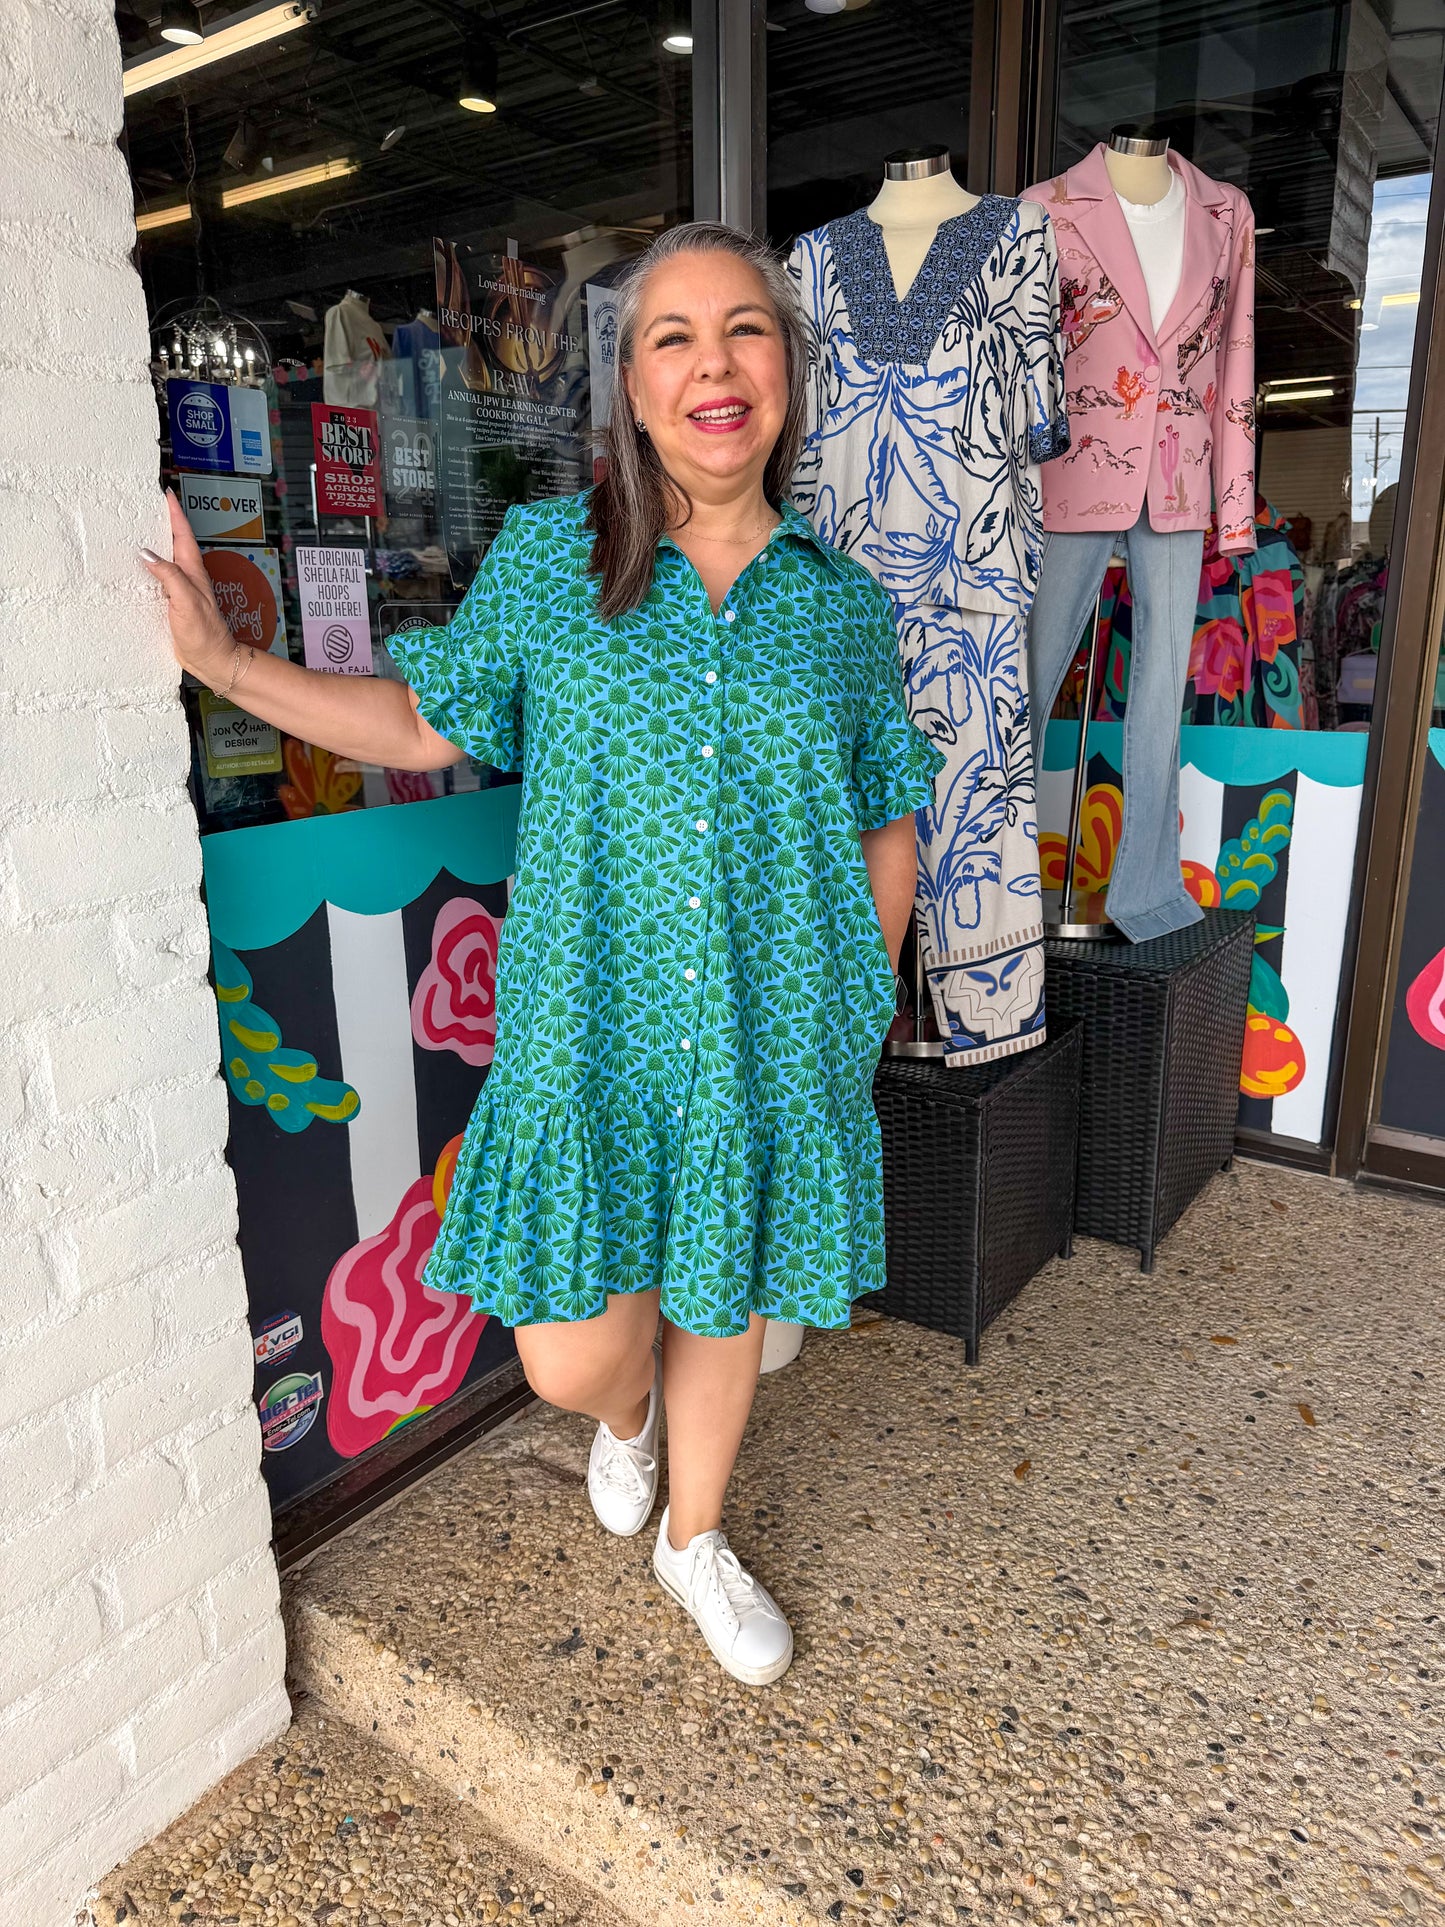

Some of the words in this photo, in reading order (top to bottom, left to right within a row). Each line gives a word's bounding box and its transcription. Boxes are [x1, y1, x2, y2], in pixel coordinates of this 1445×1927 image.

[478, 275, 498, 290] Love
[499, 280, 506, 293] in
[507, 282, 519, 295] the
[519, 287, 546, 306] making
[440, 308, 501, 337] RECIPES
[506, 323, 546, 347] FROM
[551, 332, 579, 353] THE
[493, 369, 534, 396] RAW
[448, 390, 482, 405] ANNUAL
[483, 394, 500, 407] JPW
[502, 398, 544, 414] LEARNING
[545, 406, 577, 418] CENTER
[187, 409, 214, 421] SHOP
[334, 414, 357, 424] 2023
[476, 407, 526, 423] COOKBOOK
[527, 416, 550, 426] GALA
[185, 419, 218, 431] SMALL
[320, 422, 372, 449] BEST
[322, 444, 374, 466] STORE
[394, 446, 430, 468] BEST
[324, 473, 374, 485] SHOP
[392, 468, 436, 490] STORE
[325, 484, 376, 494] ACROSS
[326, 492, 376, 503] TEXAS
[188, 494, 258, 513] DISCOVER
[298, 550, 317, 566] THE
[319, 550, 362, 566] ORIGINAL
[304, 567, 338, 582] SHEILA
[340, 568, 360, 583] FAJL
[318, 585, 350, 600] HOOPS
[308, 602, 332, 617] SOLD
[335, 602, 362, 616] HERE!
[213, 727, 231, 736] JON
[250, 724, 271, 732] HART
[225, 738, 258, 748] DESIGN
[270, 1325, 298, 1346] VGI
[275, 1334, 300, 1351] SECURITY
[260, 1377, 320, 1424] ner-Tel
[267, 1407, 311, 1437] Ener-Tel.com
